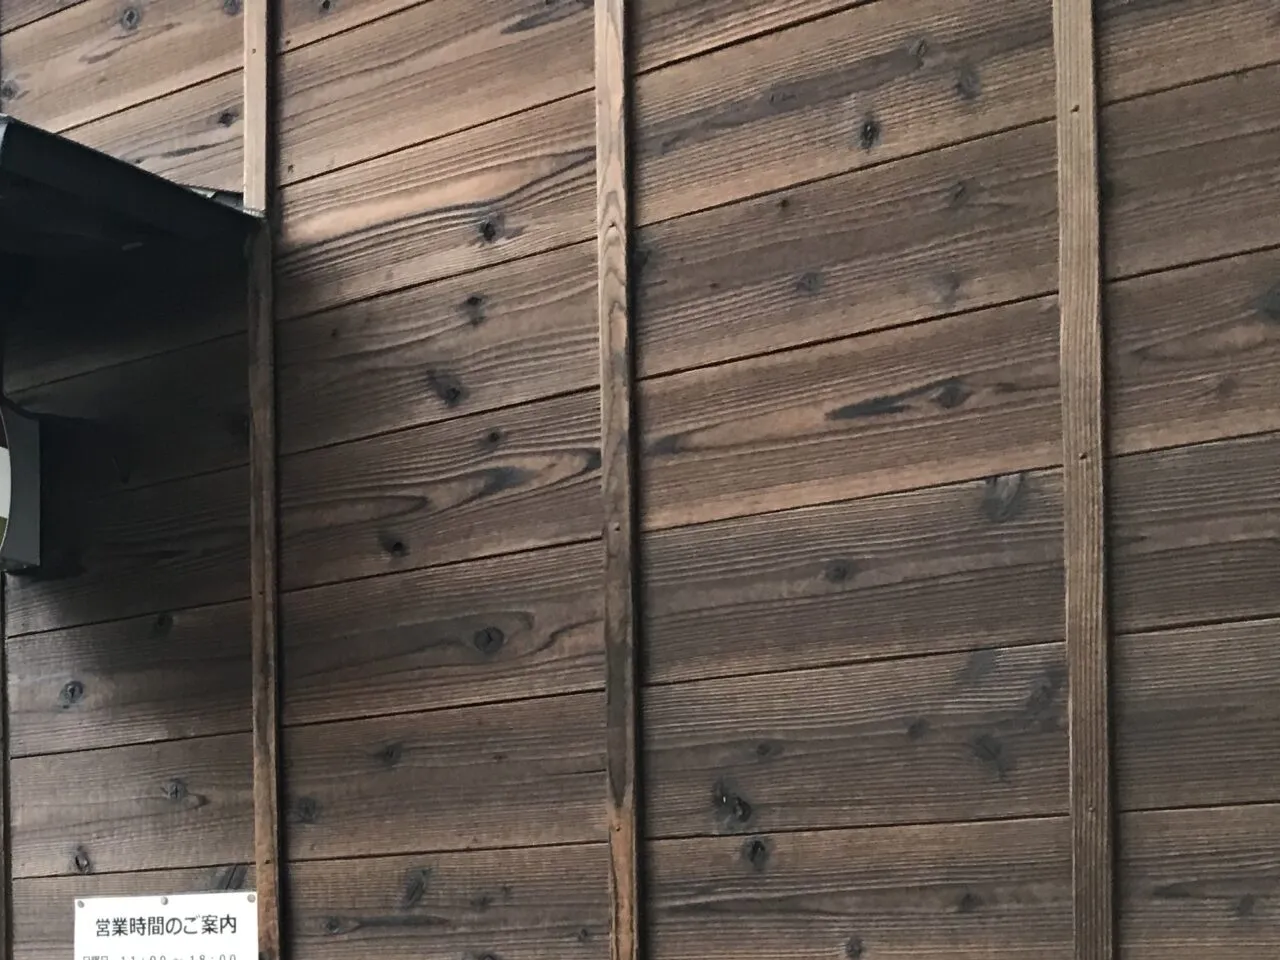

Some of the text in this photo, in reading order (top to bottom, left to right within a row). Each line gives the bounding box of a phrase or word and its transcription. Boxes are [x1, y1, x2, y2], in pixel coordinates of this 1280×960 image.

[96, 914, 237, 937] 営業時間のご案内
